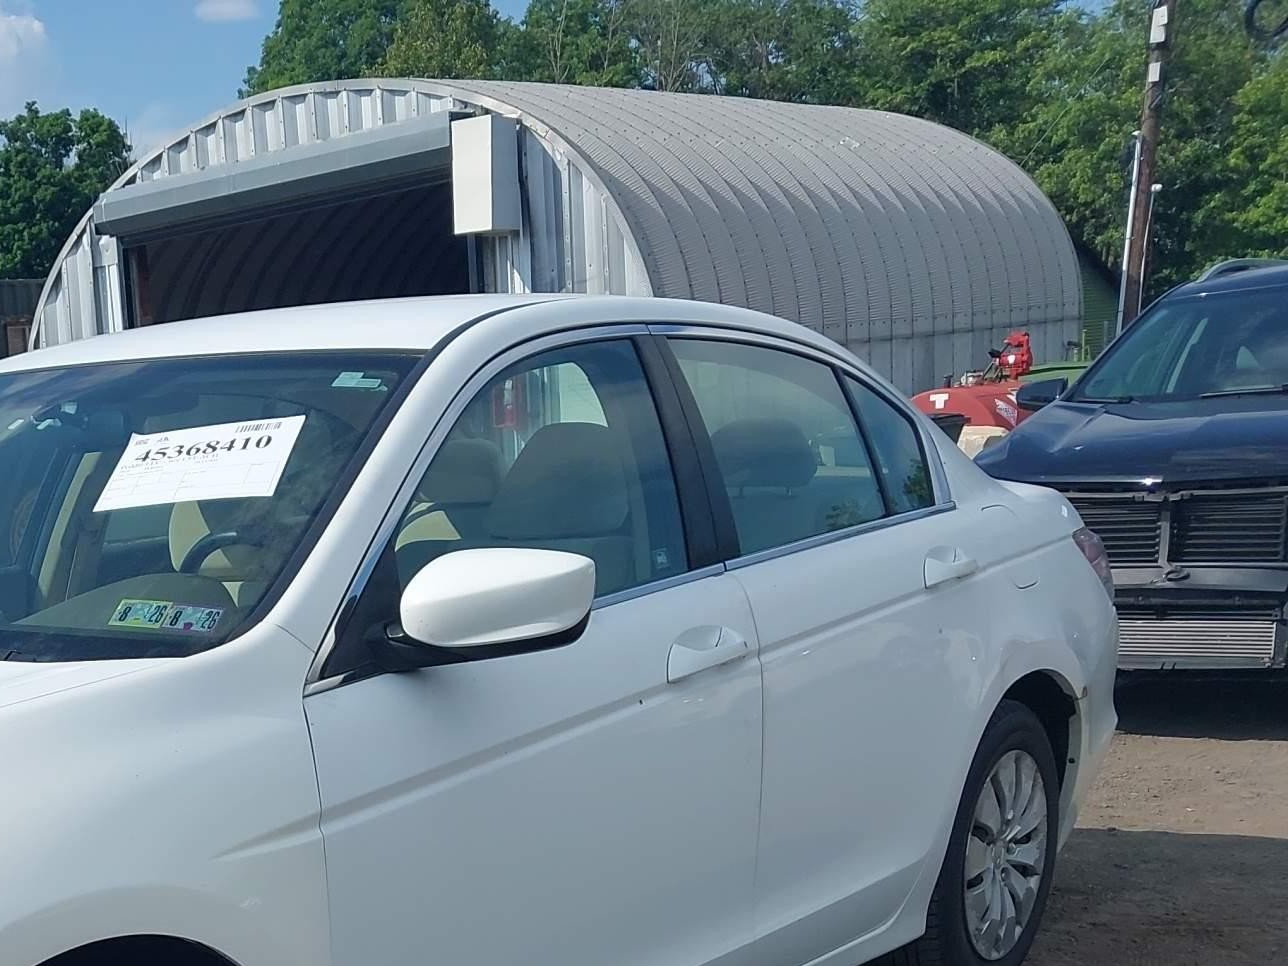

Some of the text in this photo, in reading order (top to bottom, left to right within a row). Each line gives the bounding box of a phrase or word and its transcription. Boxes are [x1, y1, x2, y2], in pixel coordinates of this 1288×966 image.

[929, 393, 949, 409] T
[135, 434, 273, 463] 45368410
[118, 605, 168, 624] 8 26
[169, 610, 221, 630] 8 26
